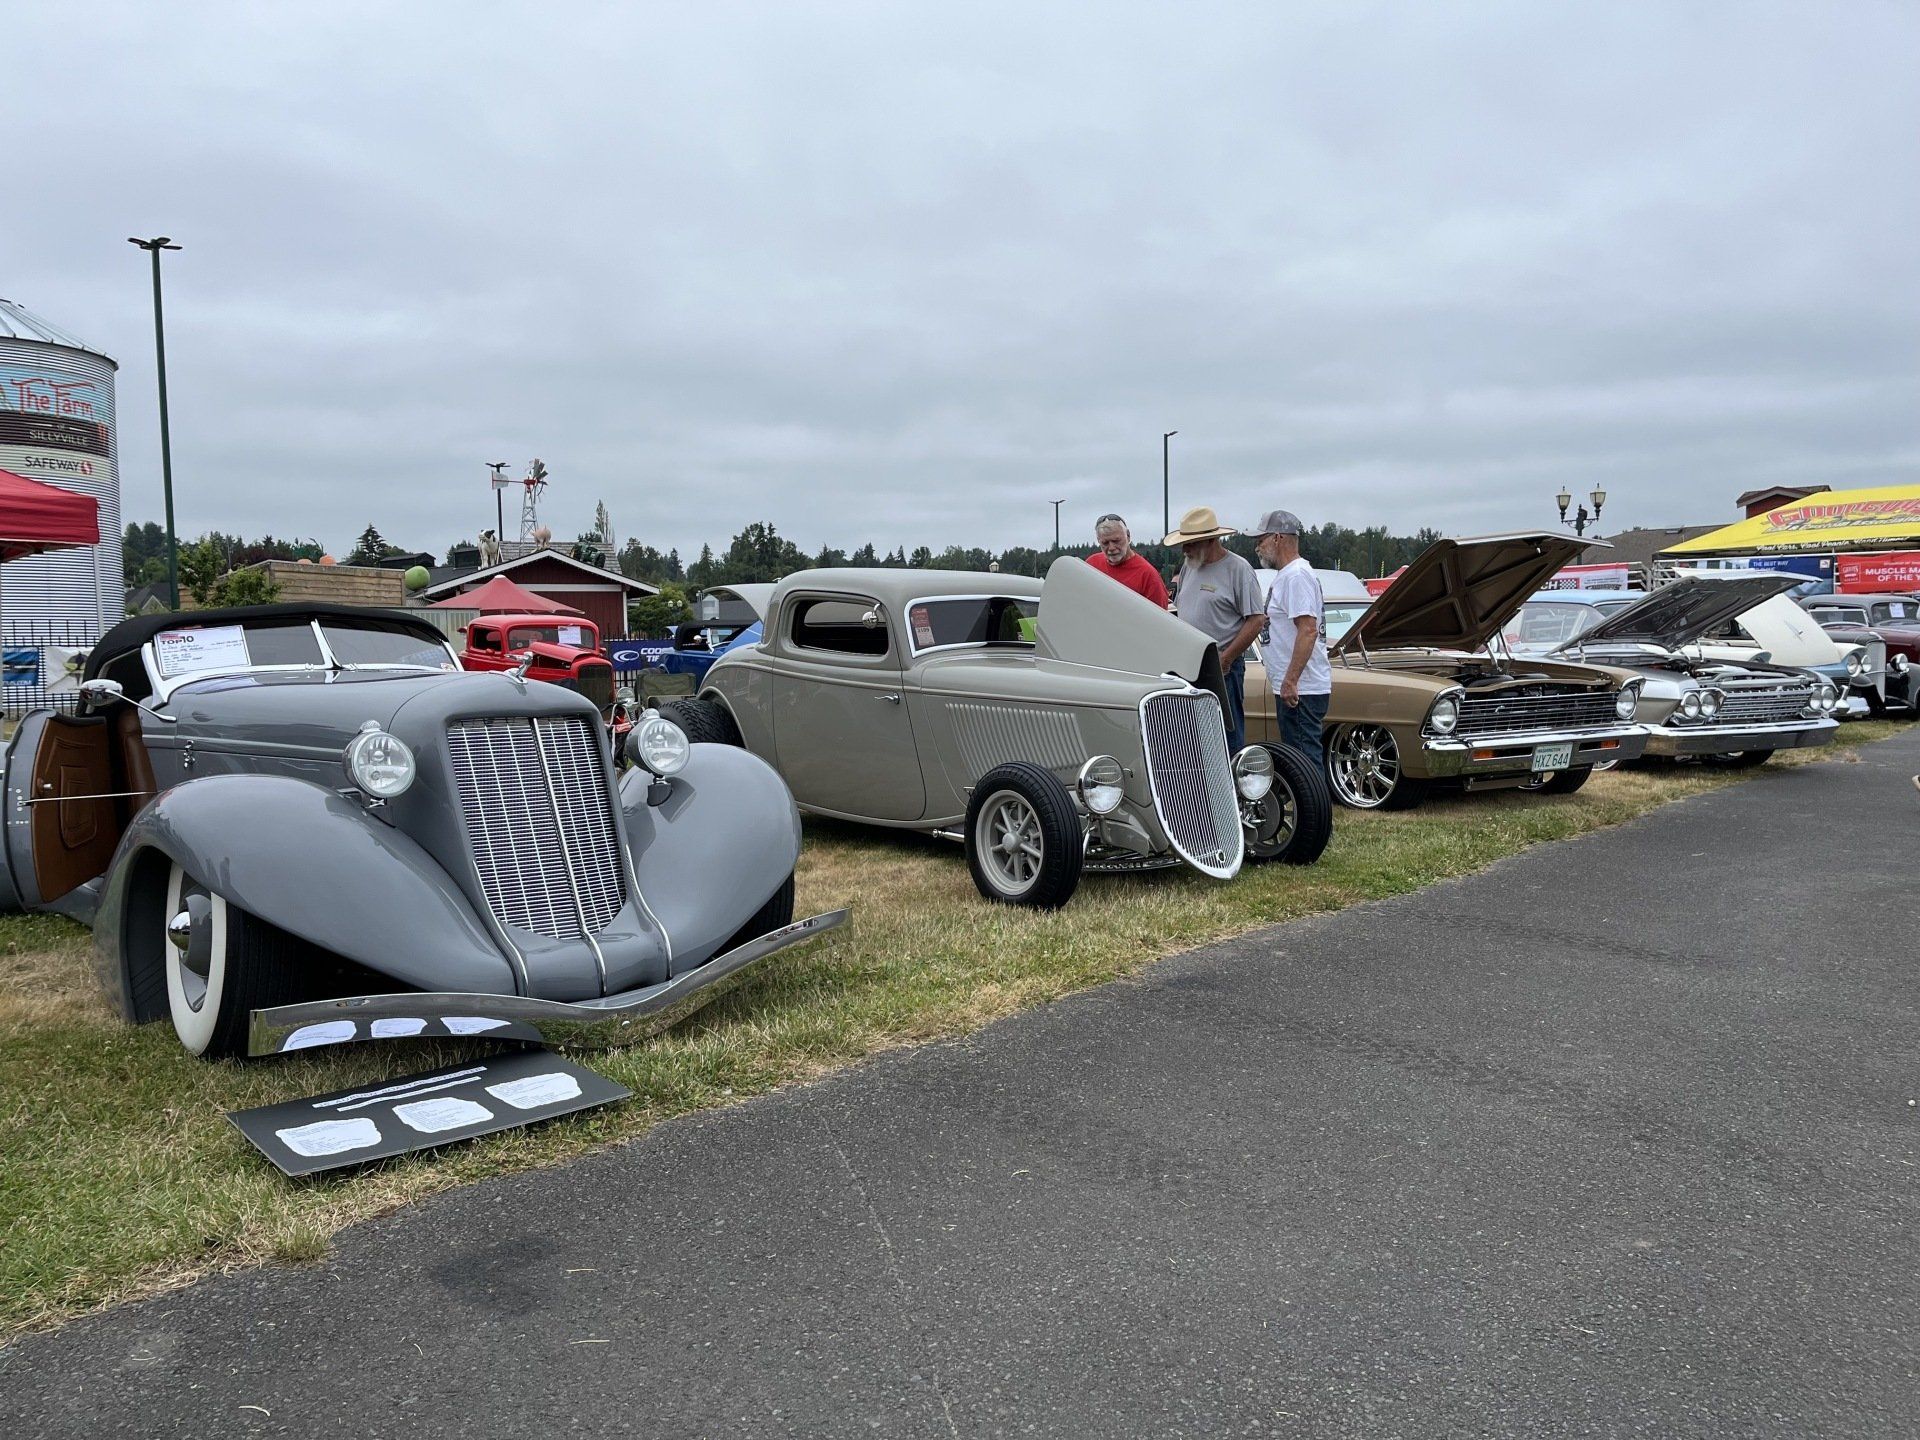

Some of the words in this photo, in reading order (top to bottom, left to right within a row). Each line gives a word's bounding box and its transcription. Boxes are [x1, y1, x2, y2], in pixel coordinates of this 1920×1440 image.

[11, 378, 50, 416] The
[48, 380, 97, 421] Farm
[25, 457, 79, 471] SAFEWAY
[1865, 567, 1906, 575] MUSCLE
[1535, 754, 1551, 768] HXZ
[1551, 753, 1569, 767] 644
